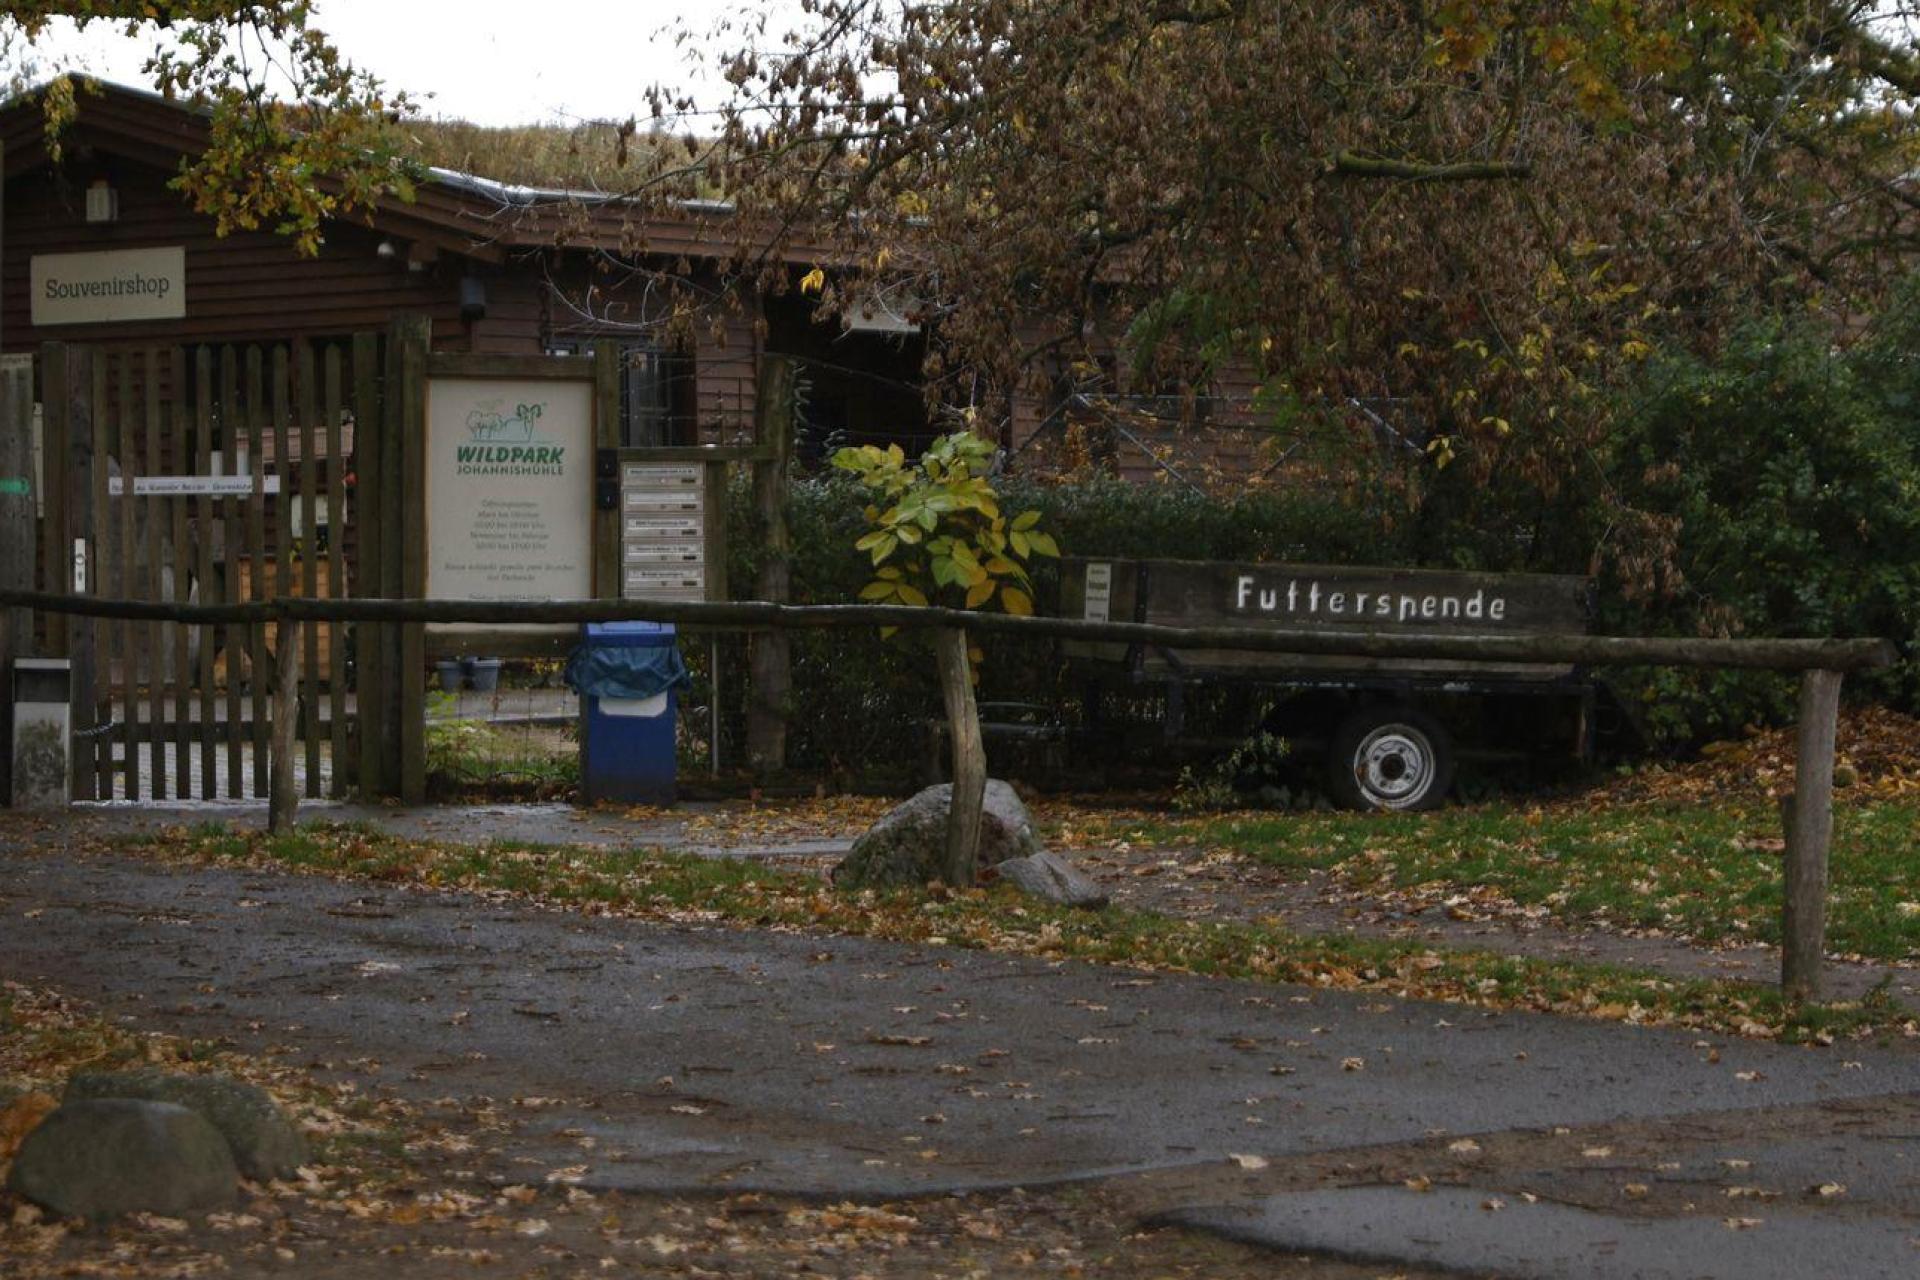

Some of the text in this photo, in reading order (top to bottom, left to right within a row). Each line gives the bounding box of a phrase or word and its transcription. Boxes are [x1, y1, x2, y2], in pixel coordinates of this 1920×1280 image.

[45, 273, 170, 299] Souvenirshop
[457, 446, 565, 464] WILDPARK
[1237, 577, 1505, 620] Futterspende
